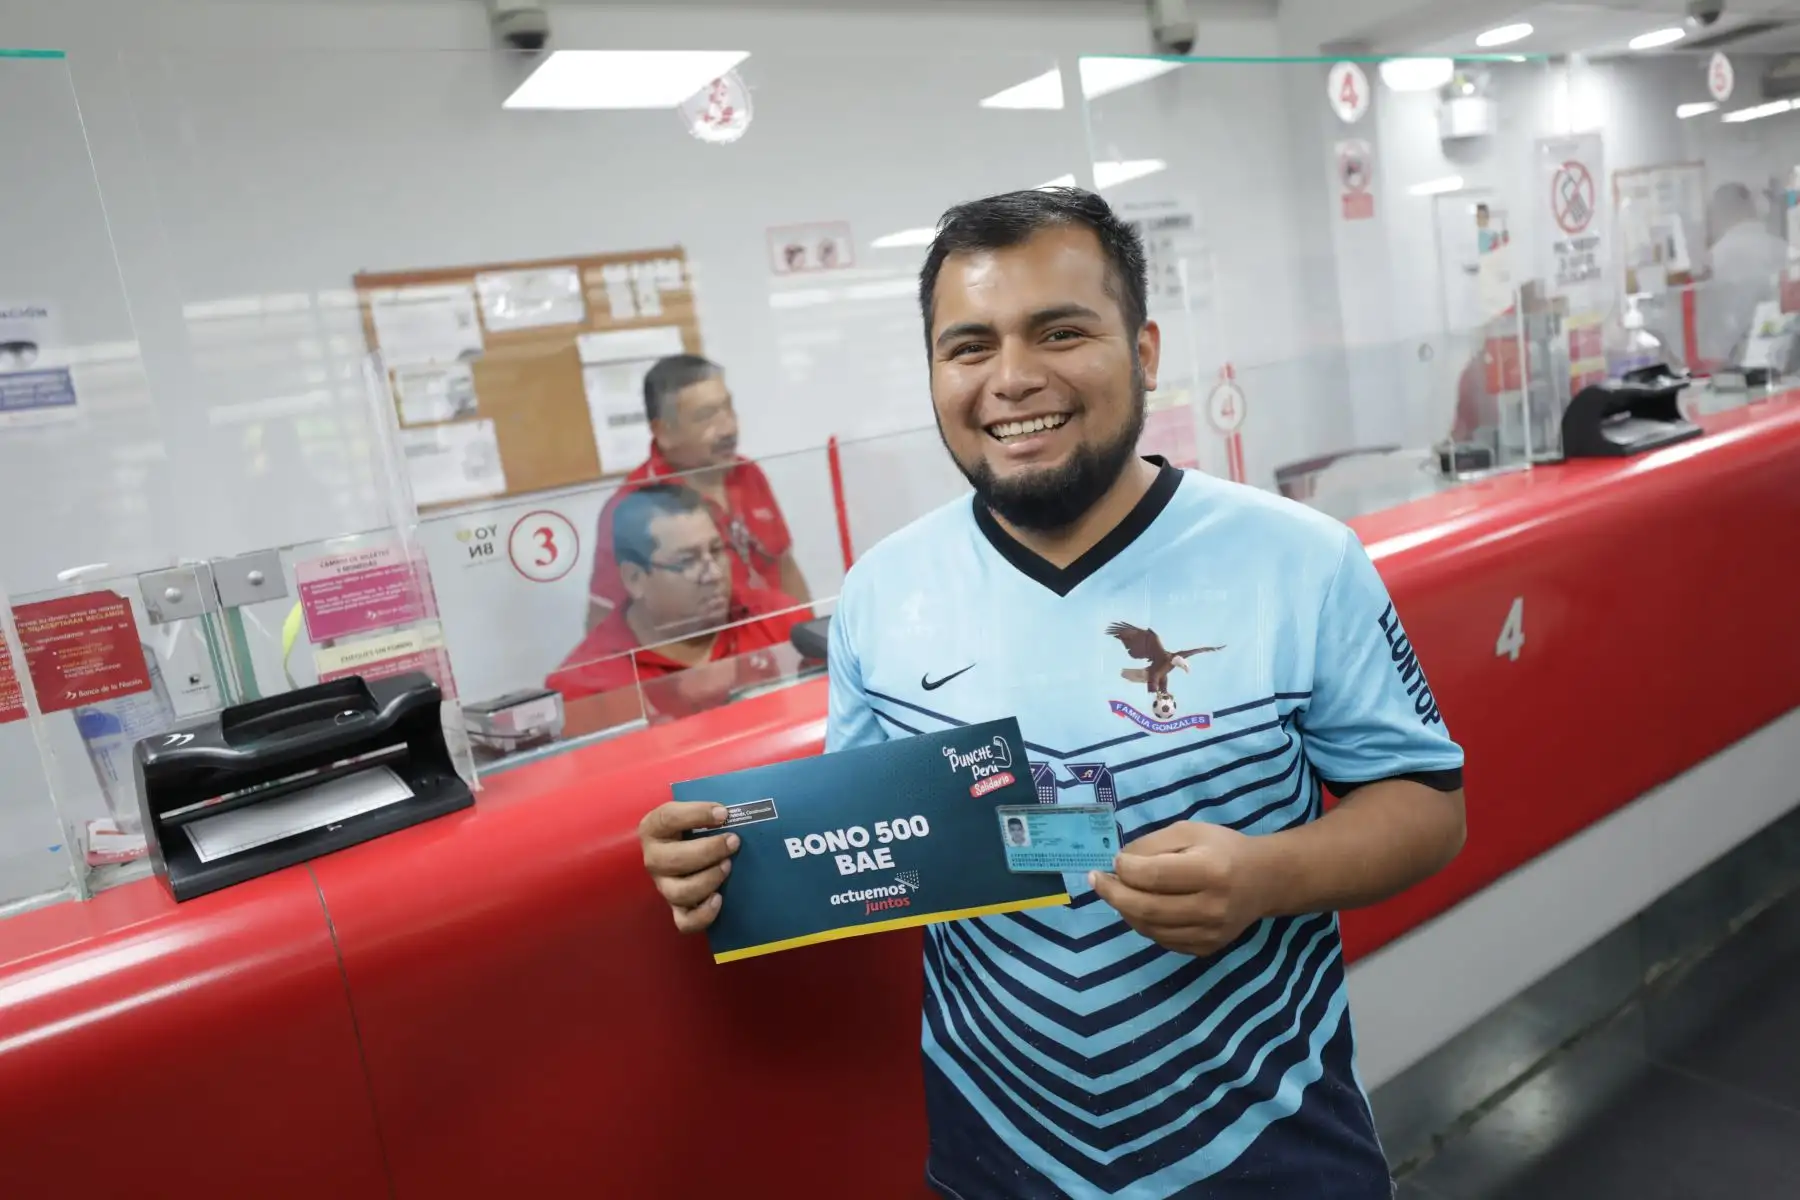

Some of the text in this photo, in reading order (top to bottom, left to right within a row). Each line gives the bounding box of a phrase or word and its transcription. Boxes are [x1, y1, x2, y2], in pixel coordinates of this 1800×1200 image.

[1340, 71, 1359, 109] 4
[1220, 393, 1235, 418] 4
[533, 526, 558, 566] 3
[1496, 596, 1526, 662] 4
[1378, 601, 1440, 725] LLONTOP
[78, 678, 143, 698] Banco de la Nación
[1116, 703, 1205, 732] FAMILIA GONZALES
[942, 746, 957, 757] Con
[949, 745, 993, 773] PUNCHE
[971, 760, 999, 780] Perú
[974, 775, 1010, 796] Solidario
[784, 814, 930, 859] BONO 500
[834, 846, 896, 876] BAE
[830, 883, 907, 906] actuemos
[865, 896, 911, 916] juntos
